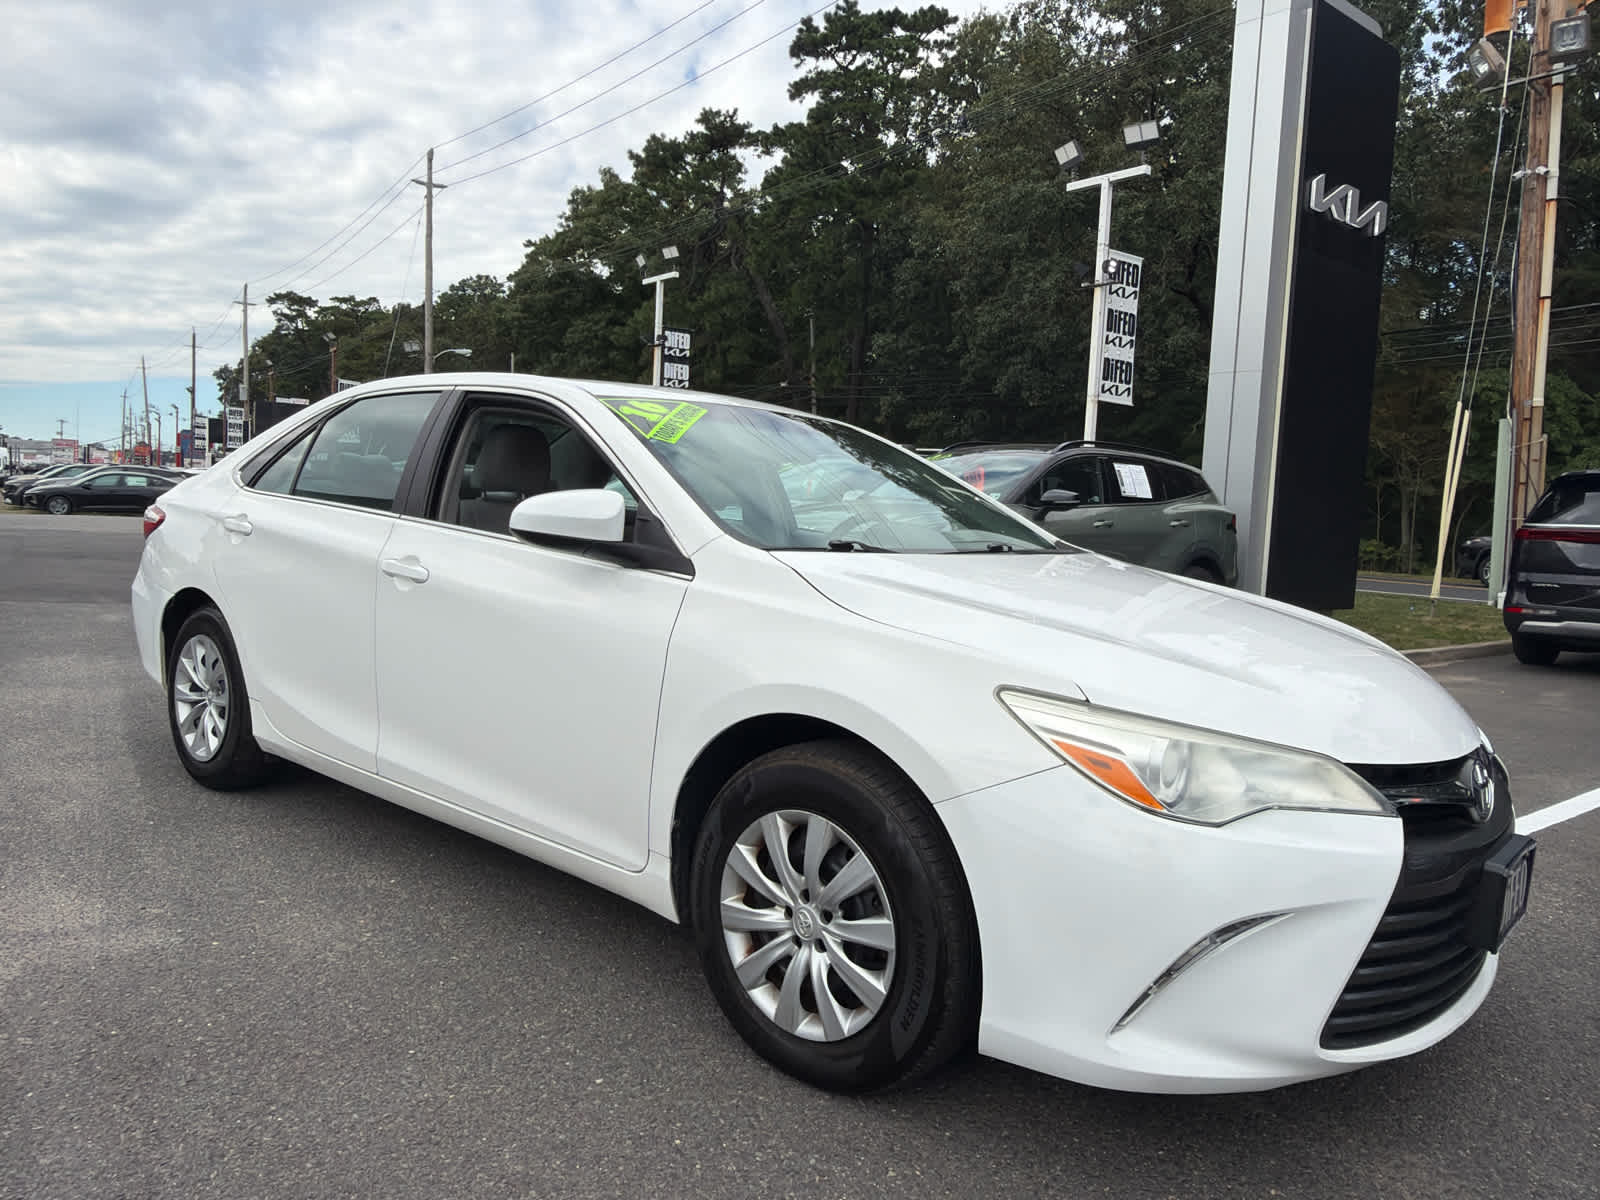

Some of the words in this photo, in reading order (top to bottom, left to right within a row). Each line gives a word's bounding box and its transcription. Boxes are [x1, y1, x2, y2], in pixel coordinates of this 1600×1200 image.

[1310, 173, 1388, 236] KIA
[1108, 284, 1138, 300] KIA
[1105, 334, 1134, 350] KIA
[664, 348, 689, 357] KIA
[1101, 383, 1131, 398] KIA
